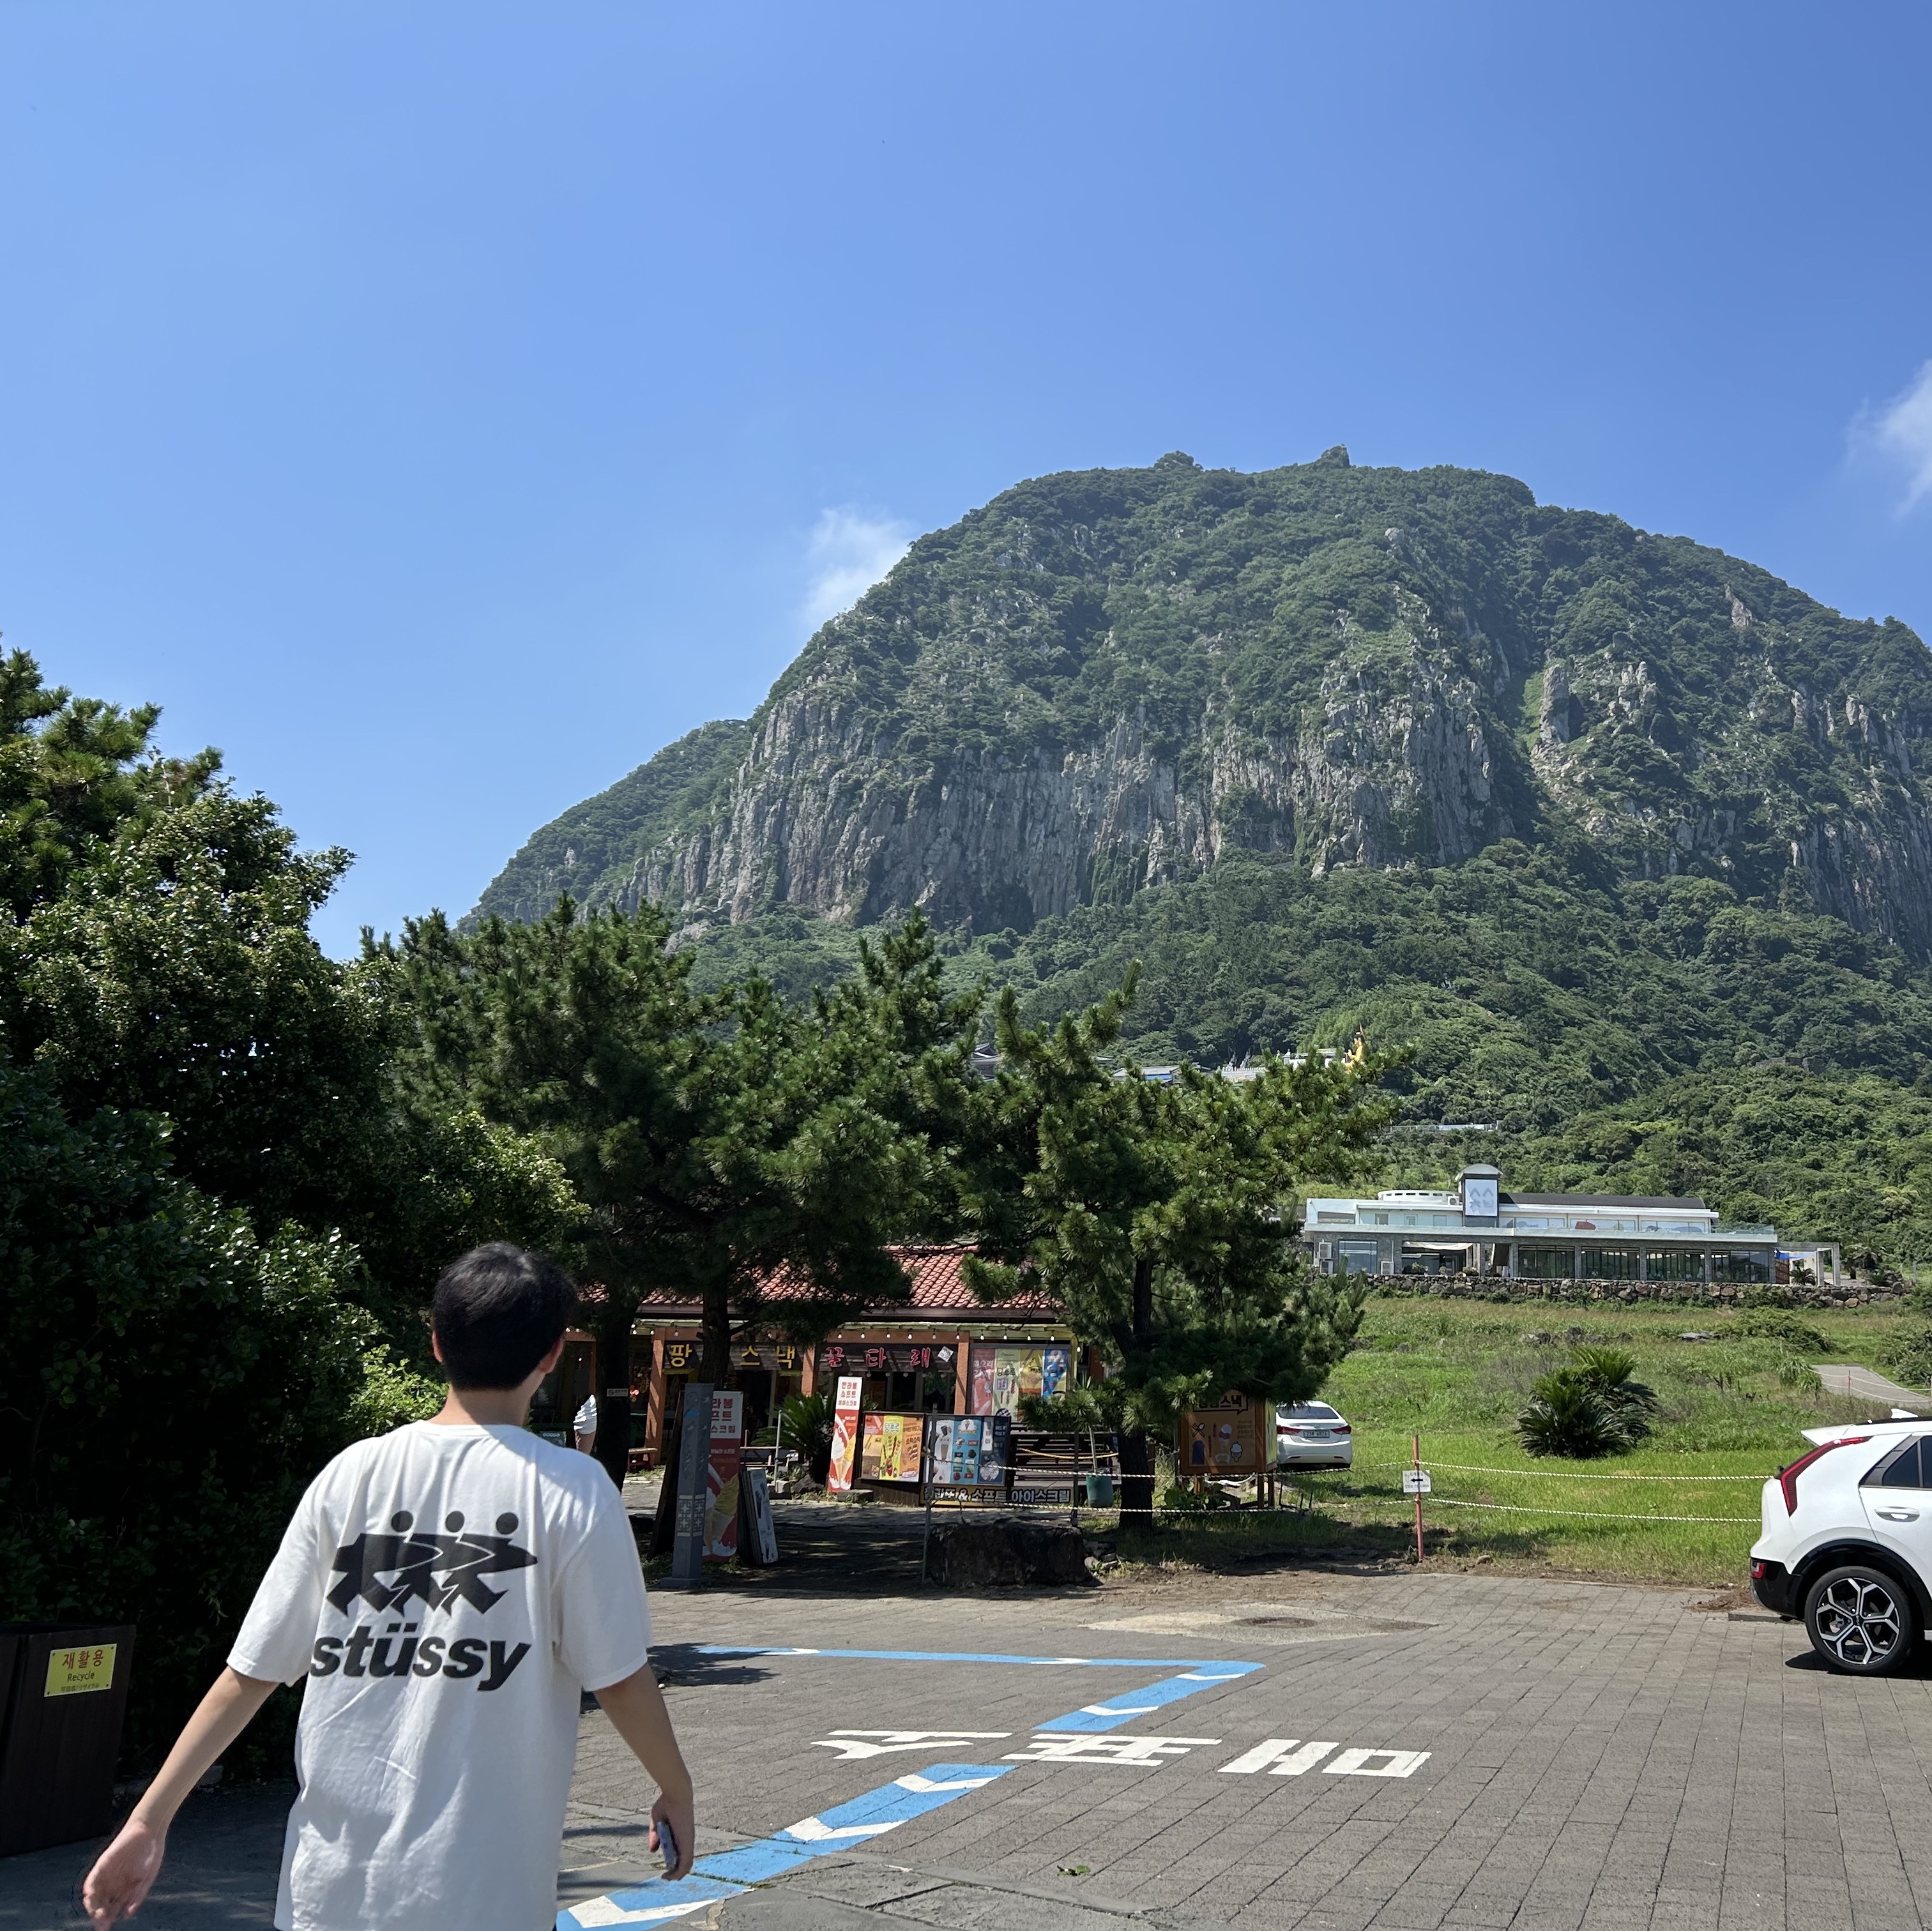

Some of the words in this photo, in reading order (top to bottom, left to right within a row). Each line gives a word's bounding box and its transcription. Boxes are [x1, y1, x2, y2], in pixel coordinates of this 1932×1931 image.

[825, 1346, 931, 1368] 꿀타래
[711, 1398, 733, 1409] 라봉
[711, 1411, 733, 1421] 프트
[710, 1425, 736, 1434] 스크림
[971, 1489, 1007, 1503] 소프트
[1011, 1490, 1070, 1503] 아이스크림
[62, 1649, 104, 1670] 재활용
[310, 1623, 532, 1692] stüssy
[67, 1670, 95, 1682] Recycle
